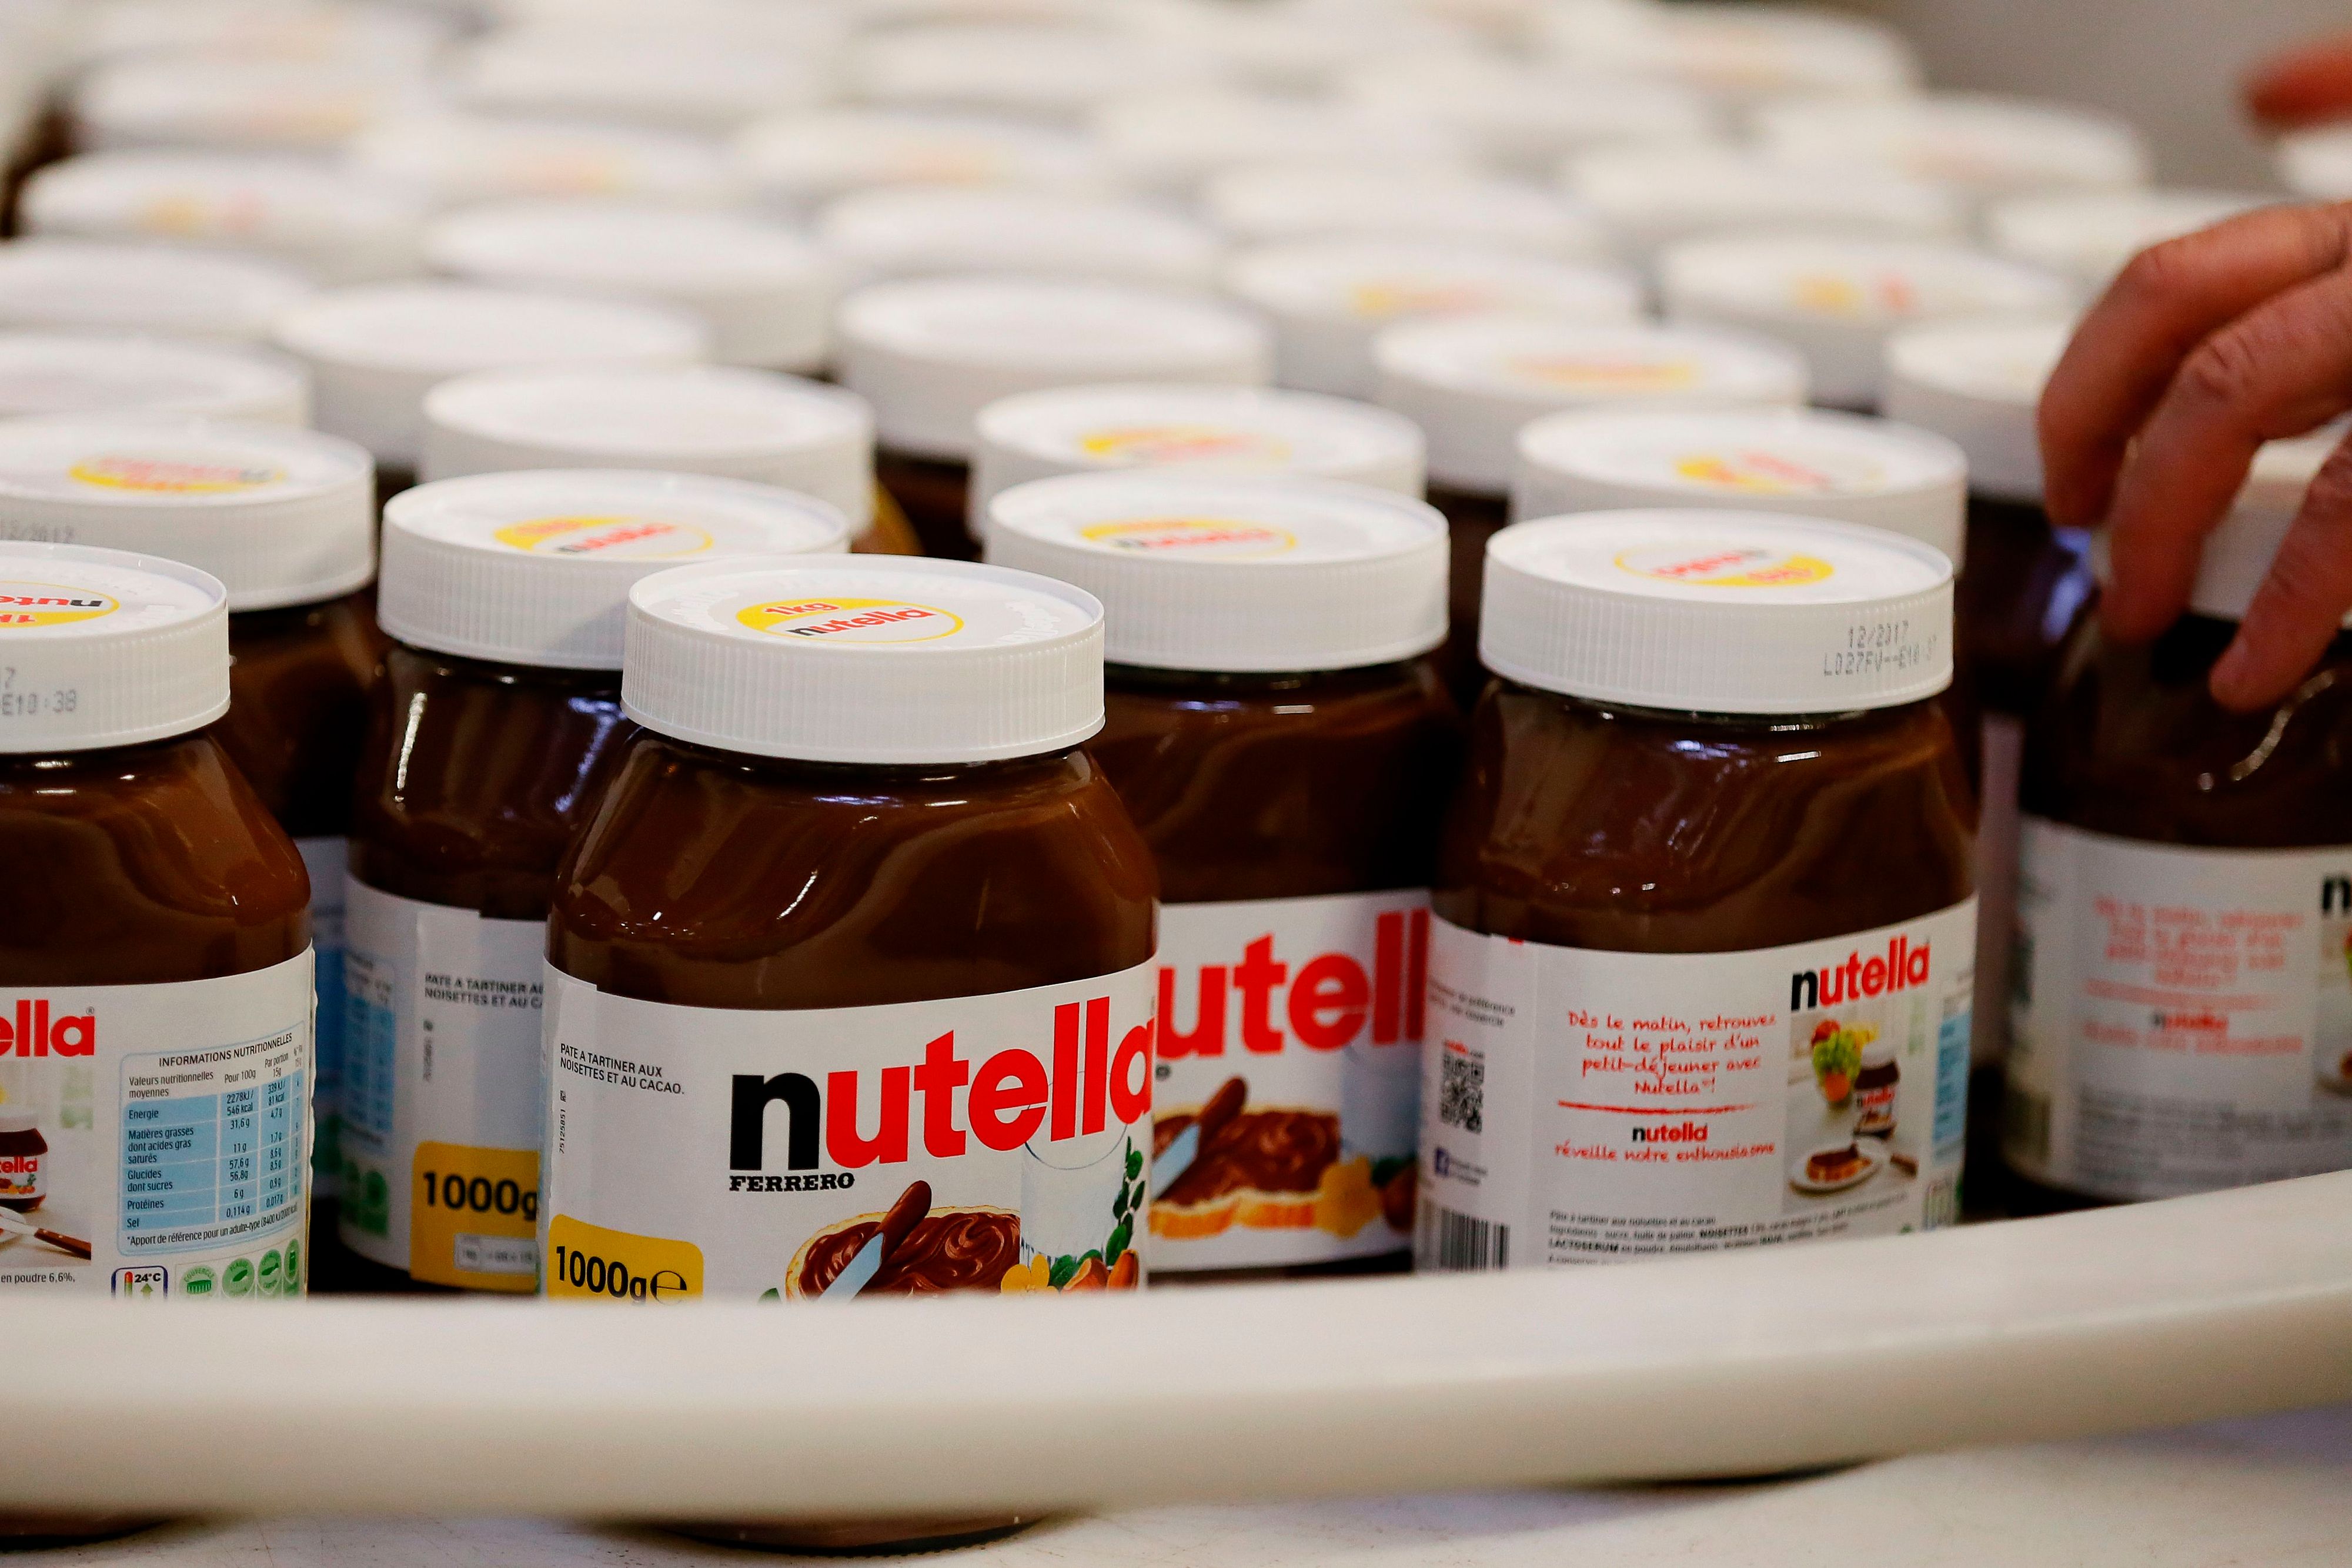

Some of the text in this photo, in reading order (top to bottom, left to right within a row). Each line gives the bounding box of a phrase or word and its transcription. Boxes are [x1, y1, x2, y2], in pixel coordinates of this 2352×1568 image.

[764, 603, 840, 614] 1kg
[786, 608, 937, 636] nutella
[1848, 620, 1909, 648] 12/2017
[1791, 934, 1930, 1011] nutella
[467, 980, 527, 994] TARTINER
[425, 987, 487, 1006] NOISETTES
[492, 995, 505, 1007] ET
[509, 997, 527, 1009] AU
[1607, 1013, 1624, 1029] le
[1633, 1015, 1690, 1035] matin,
[159, 1050, 231, 1067] INFORMATIONS
[233, 1032, 292, 1058] NUTRITIONNELLES
[1586, 1032, 1759, 1059] tout le plaisir d'un
[560, 1043, 662, 1078] PATE A TARTINER AUX
[1582, 1055, 1761, 1079] petit-déjeuner avec
[129, 1071, 213, 1086] Valeurs nutritionnelles
[225, 1069, 256, 1084] Pour 100g
[560, 1057, 684, 1094] NOISETTES ET AU CACAO.
[730, 997, 1155, 1170] nutella
[129, 1088, 169, 1099] moyennes
[129, 1109, 159, 1120] Energie
[227, 1102, 253, 1116] 546 kcal
[230, 1118, 244, 1129] 31,6
[128, 1127, 193, 1139] Matières grasses
[1632, 1121, 1708, 1142] nutella
[128, 1140, 191, 1152] dont acides gras
[233, 1144, 240, 1153] 11
[1554, 1138, 1618, 1162] réveille
[1625, 1146, 1669, 1162] notre
[0, 1156, 38, 1173] ella
[128, 1154, 157, 1164] saturés
[128, 1169, 162, 1179] Glucides
[127, 1181, 173, 1192] dont sucres
[729, 1172, 855, 1192] FERRERO
[127, 1198, 164, 1209] Protéines
[423, 1172, 537, 1222] 1000g
[127, 1218, 139, 1228] Sel
[157, 1233, 166, 1243] de
[168, 1228, 202, 1243] référence
[203, 1228, 219, 1241] pour
[220, 1228, 228, 1237] un
[15, 1272, 46, 1285] poudre
[134, 1272, 161, 1283] 24°C
